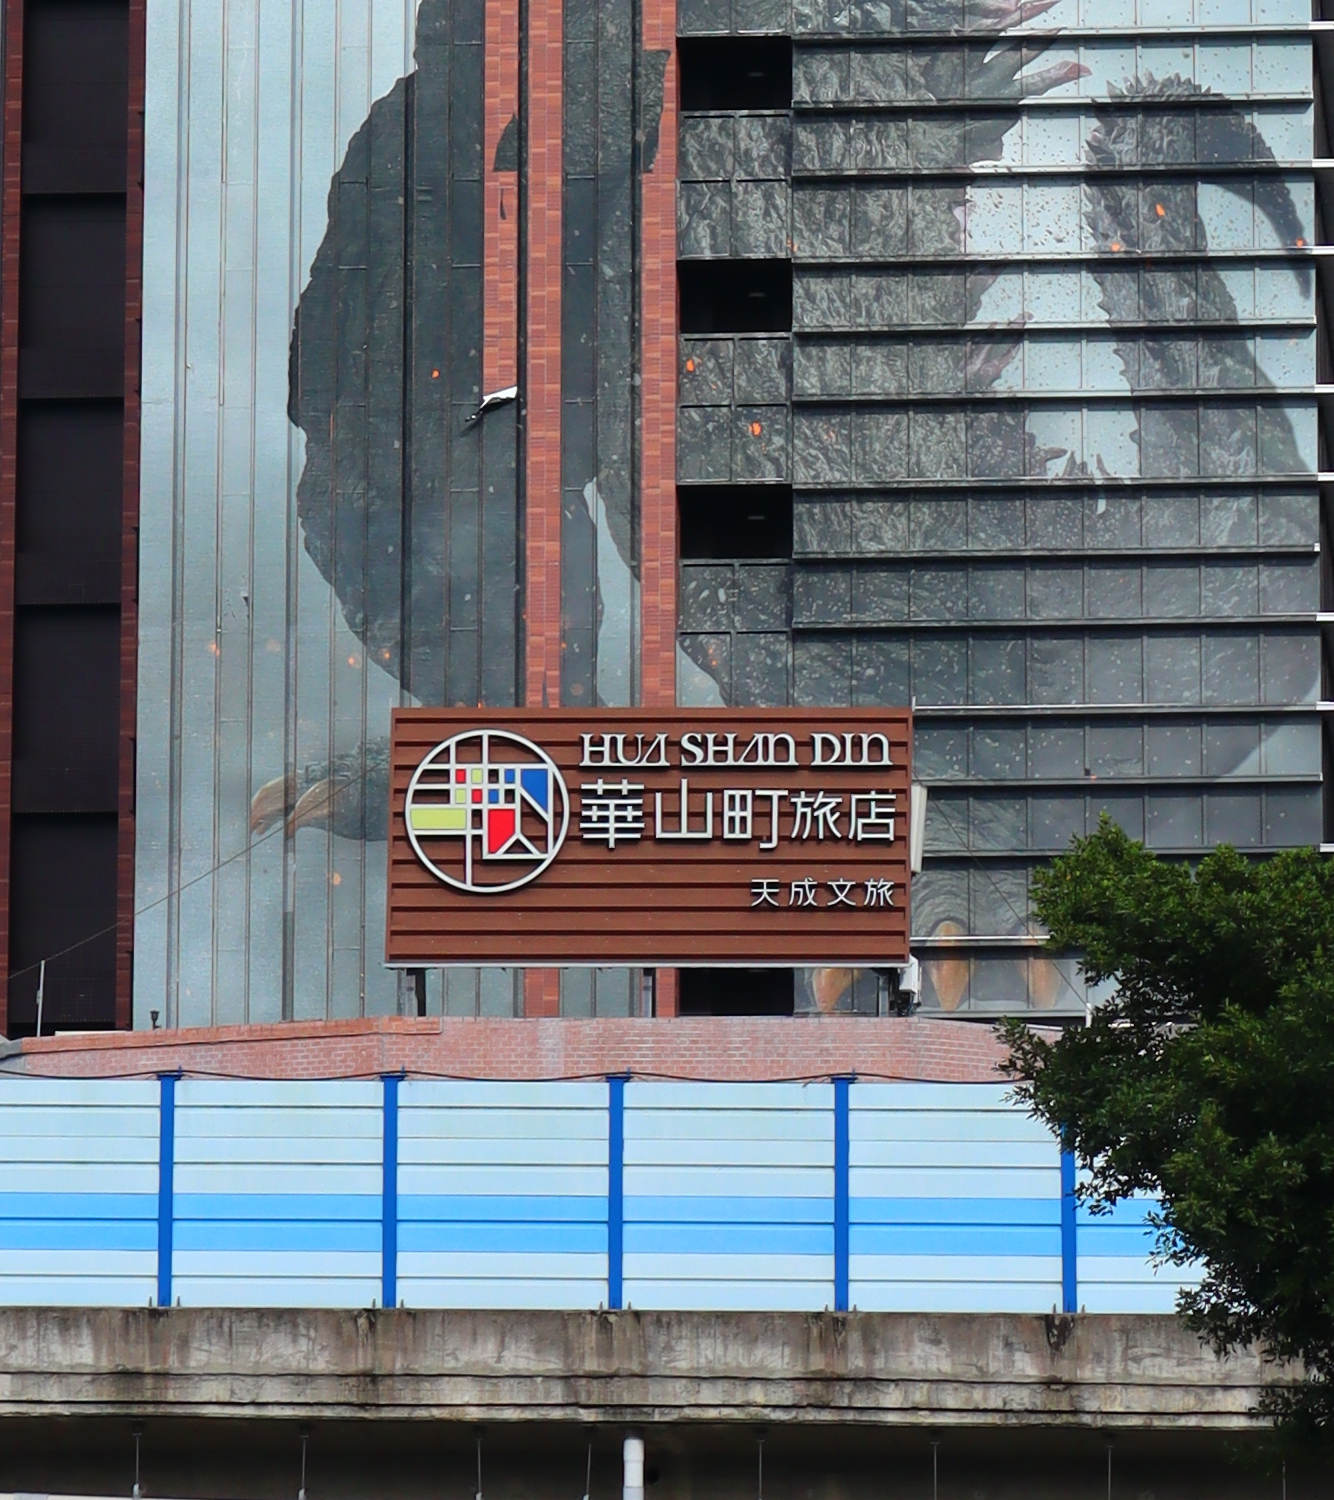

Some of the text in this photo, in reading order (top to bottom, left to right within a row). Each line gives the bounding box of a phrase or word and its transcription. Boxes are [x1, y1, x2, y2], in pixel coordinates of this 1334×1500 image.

[579, 732, 671, 767] HUA
[579, 777, 897, 849] 華山町旅店
[750, 876, 896, 908] 天成文旅
